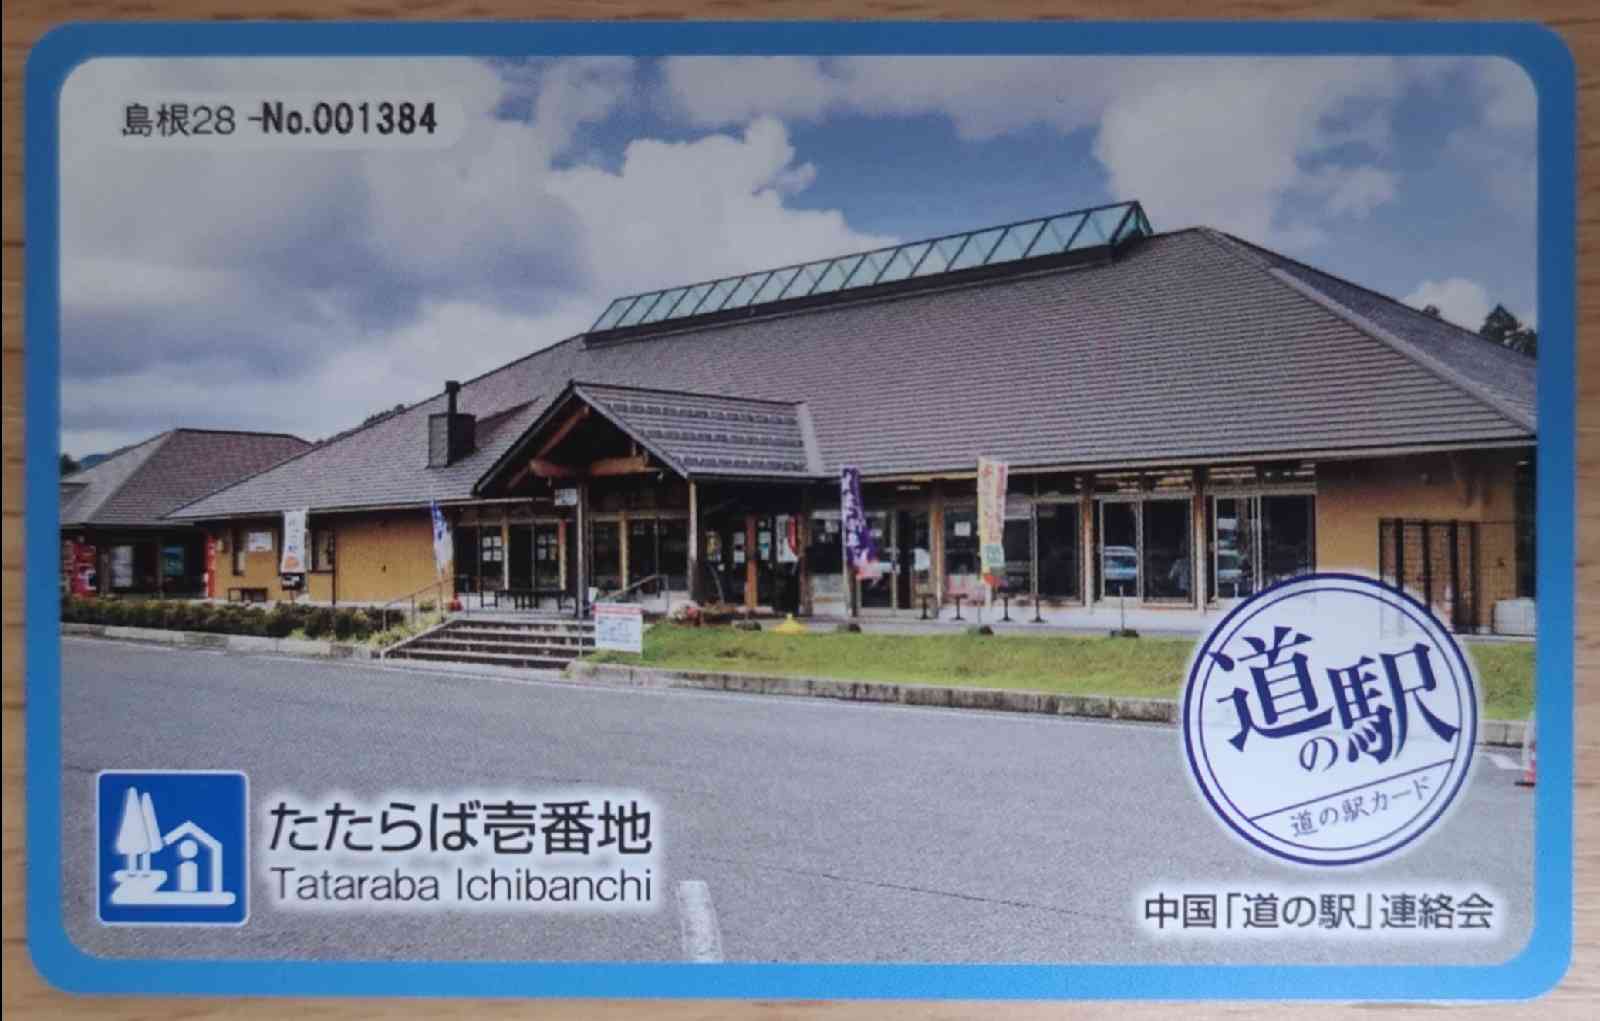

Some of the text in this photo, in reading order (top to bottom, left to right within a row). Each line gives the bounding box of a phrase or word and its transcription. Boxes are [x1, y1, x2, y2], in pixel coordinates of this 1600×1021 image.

[123, 102, 236, 136] 島根28
[1209, 626, 1460, 772] 道の駅
[268, 800, 652, 855] たたらば壱番地
[1290, 775, 1430, 838] 道の駅カード
[270, 866, 653, 902] Tataraba Ichibanchi
[1144, 892, 1494, 929] 中国「道の駅」連絡会
